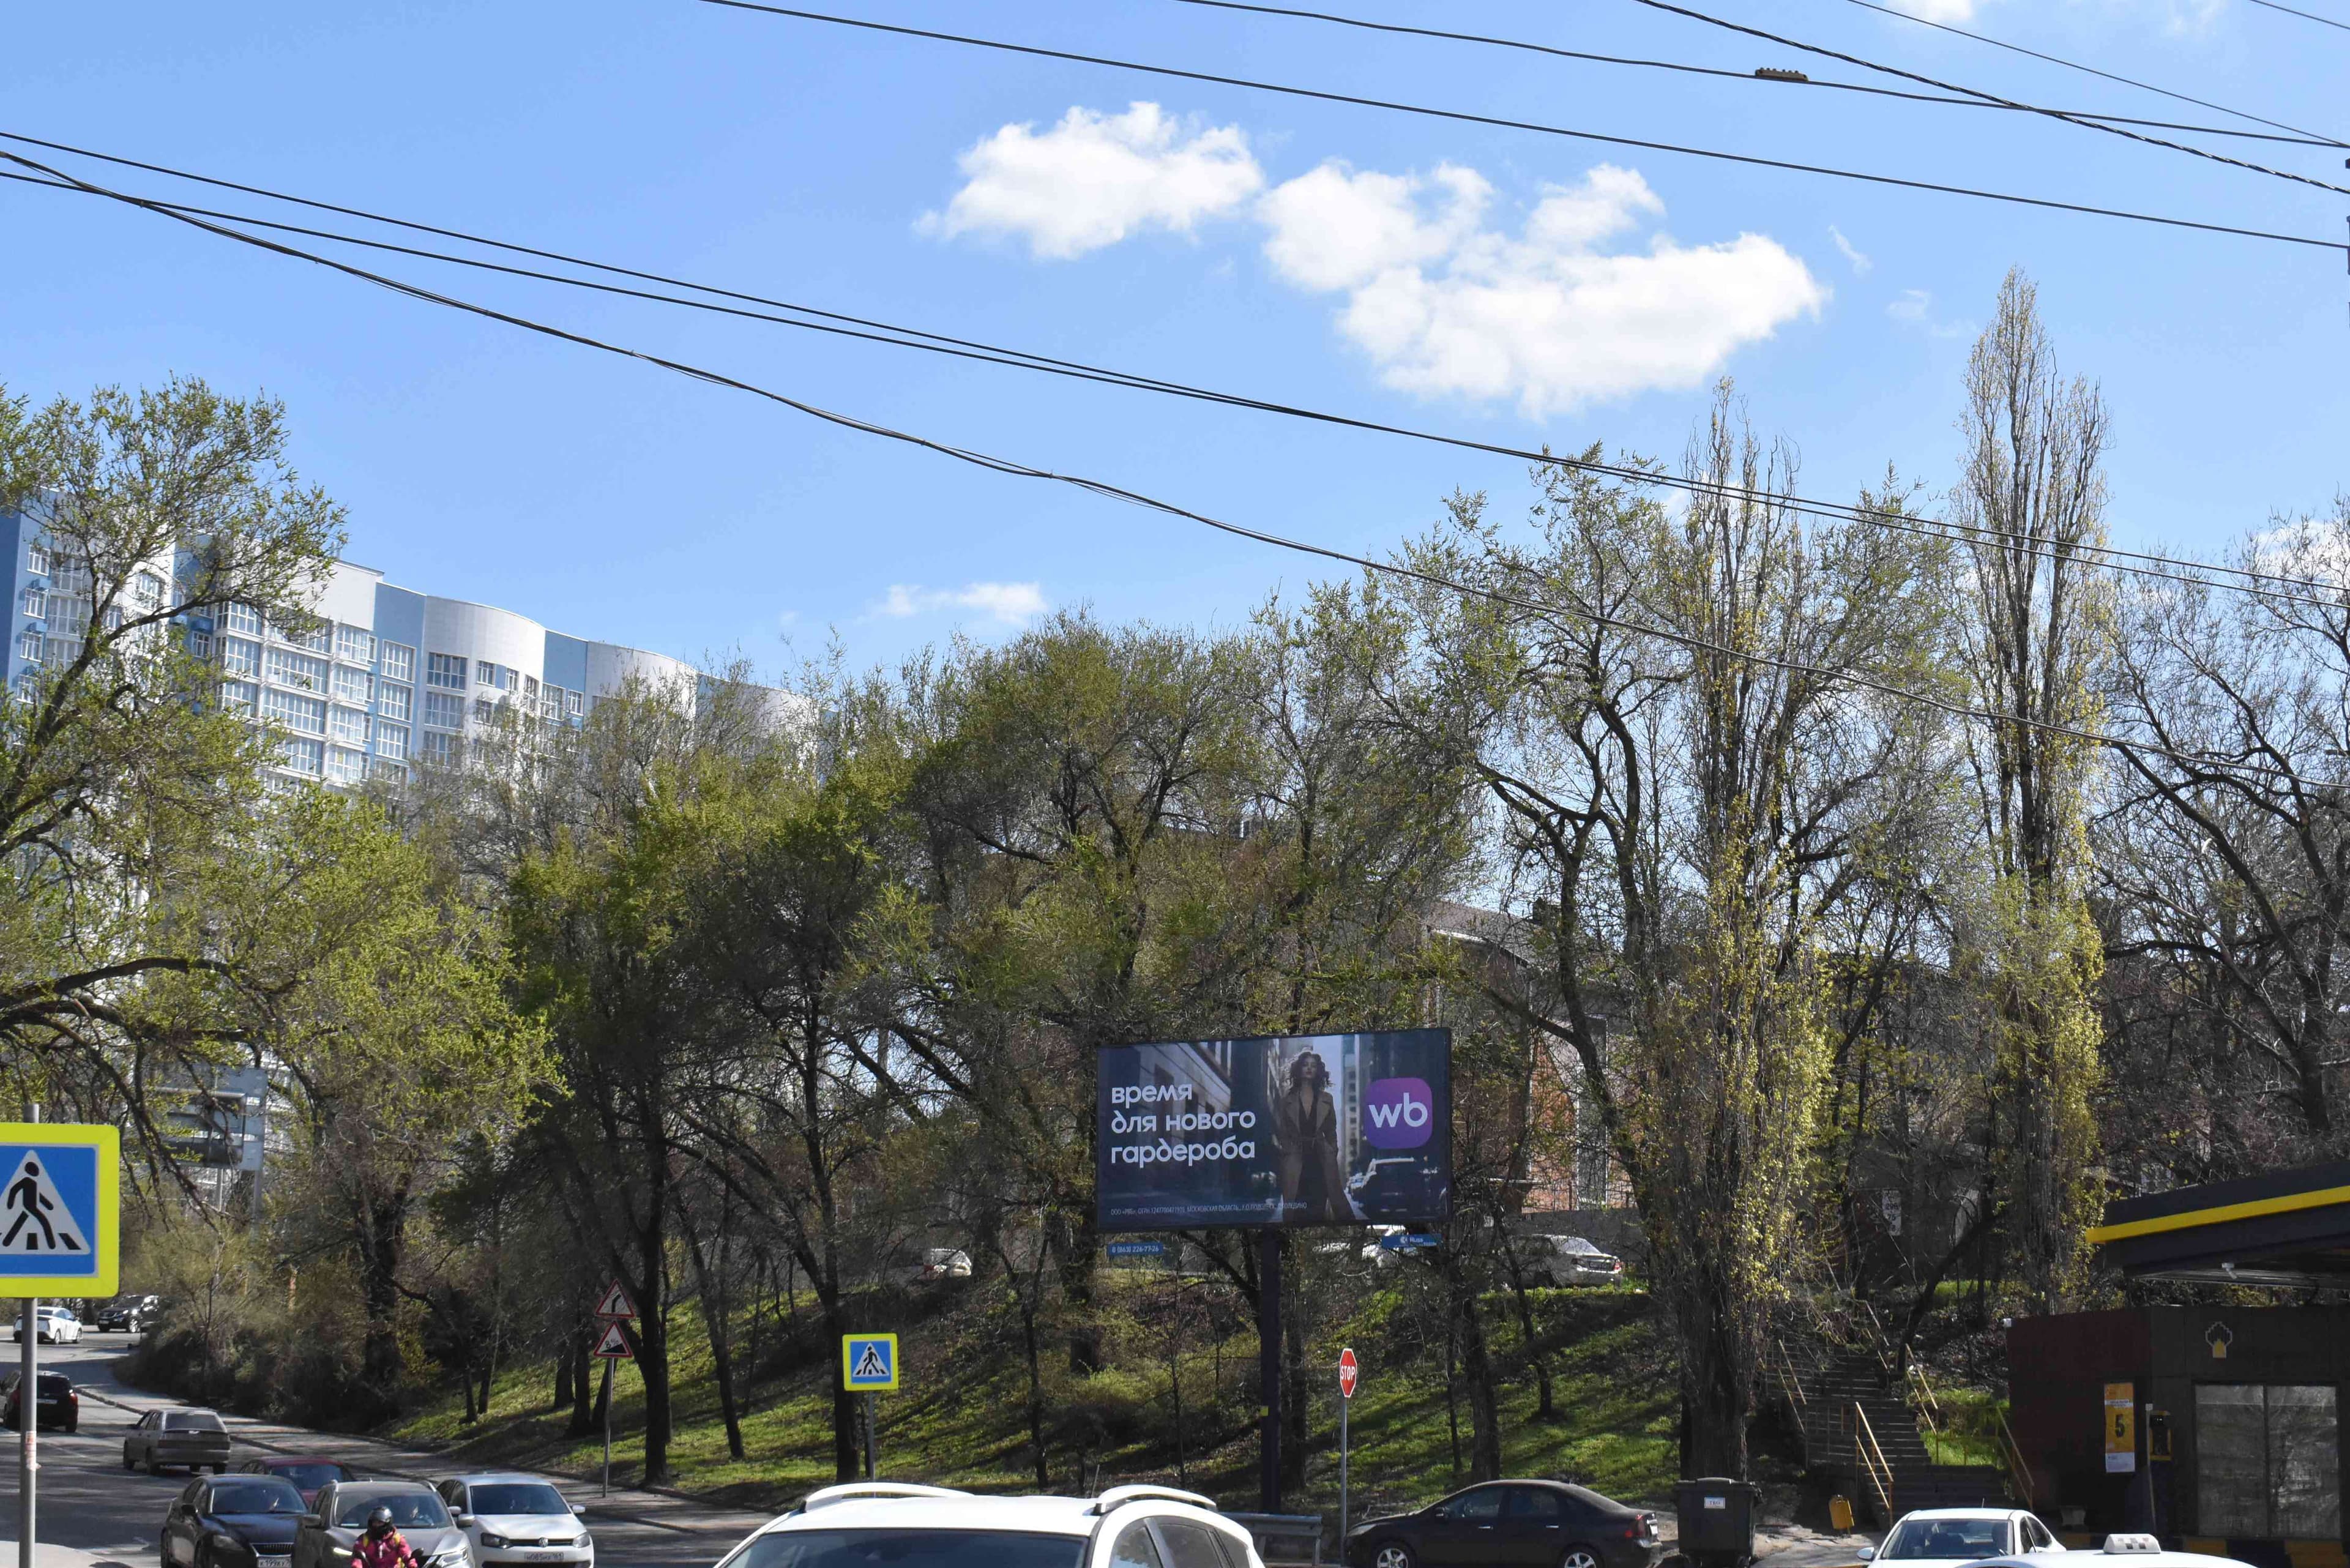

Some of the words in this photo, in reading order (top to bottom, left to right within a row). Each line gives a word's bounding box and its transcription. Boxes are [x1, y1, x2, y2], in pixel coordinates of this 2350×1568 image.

[1111, 1084, 1192, 1109] время
[1111, 1110, 1157, 1133] для
[1166, 1111, 1256, 1131] нового
[1368, 1092, 1428, 1128] wb
[1111, 1135, 1255, 1169] гардероба
[1341, 1365, 1356, 1380] STOP
[2115, 1413, 2125, 1438] 5
